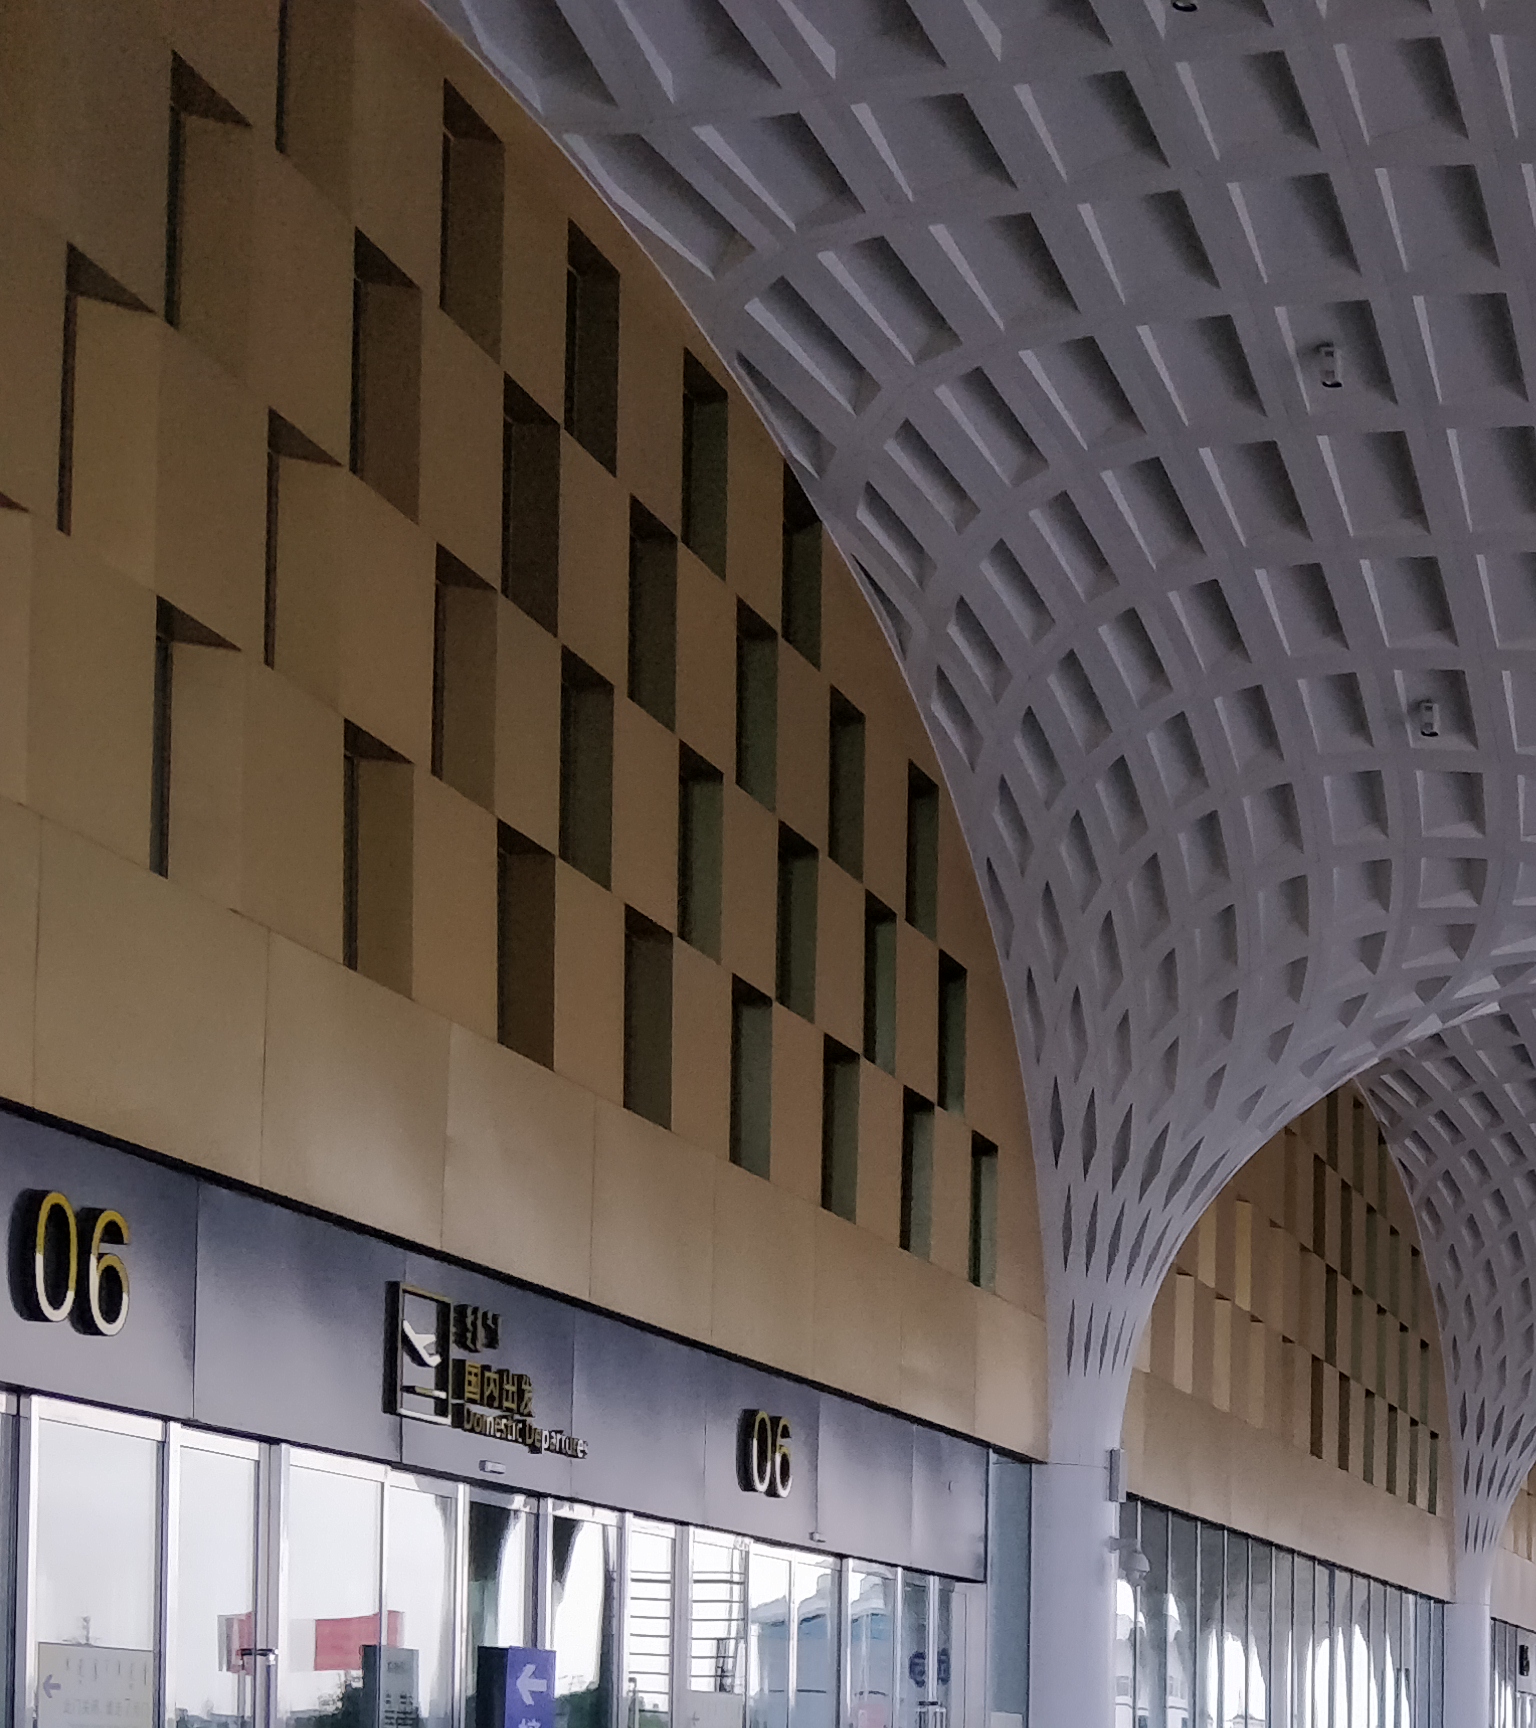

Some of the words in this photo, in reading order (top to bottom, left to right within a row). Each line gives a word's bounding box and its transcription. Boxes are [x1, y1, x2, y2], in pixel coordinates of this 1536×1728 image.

[34, 1190, 131, 1336] 06
[464, 1406, 523, 1444] Domestic
[465, 1361, 534, 1417] 国内出发
[752, 1410, 793, 1498] 06
